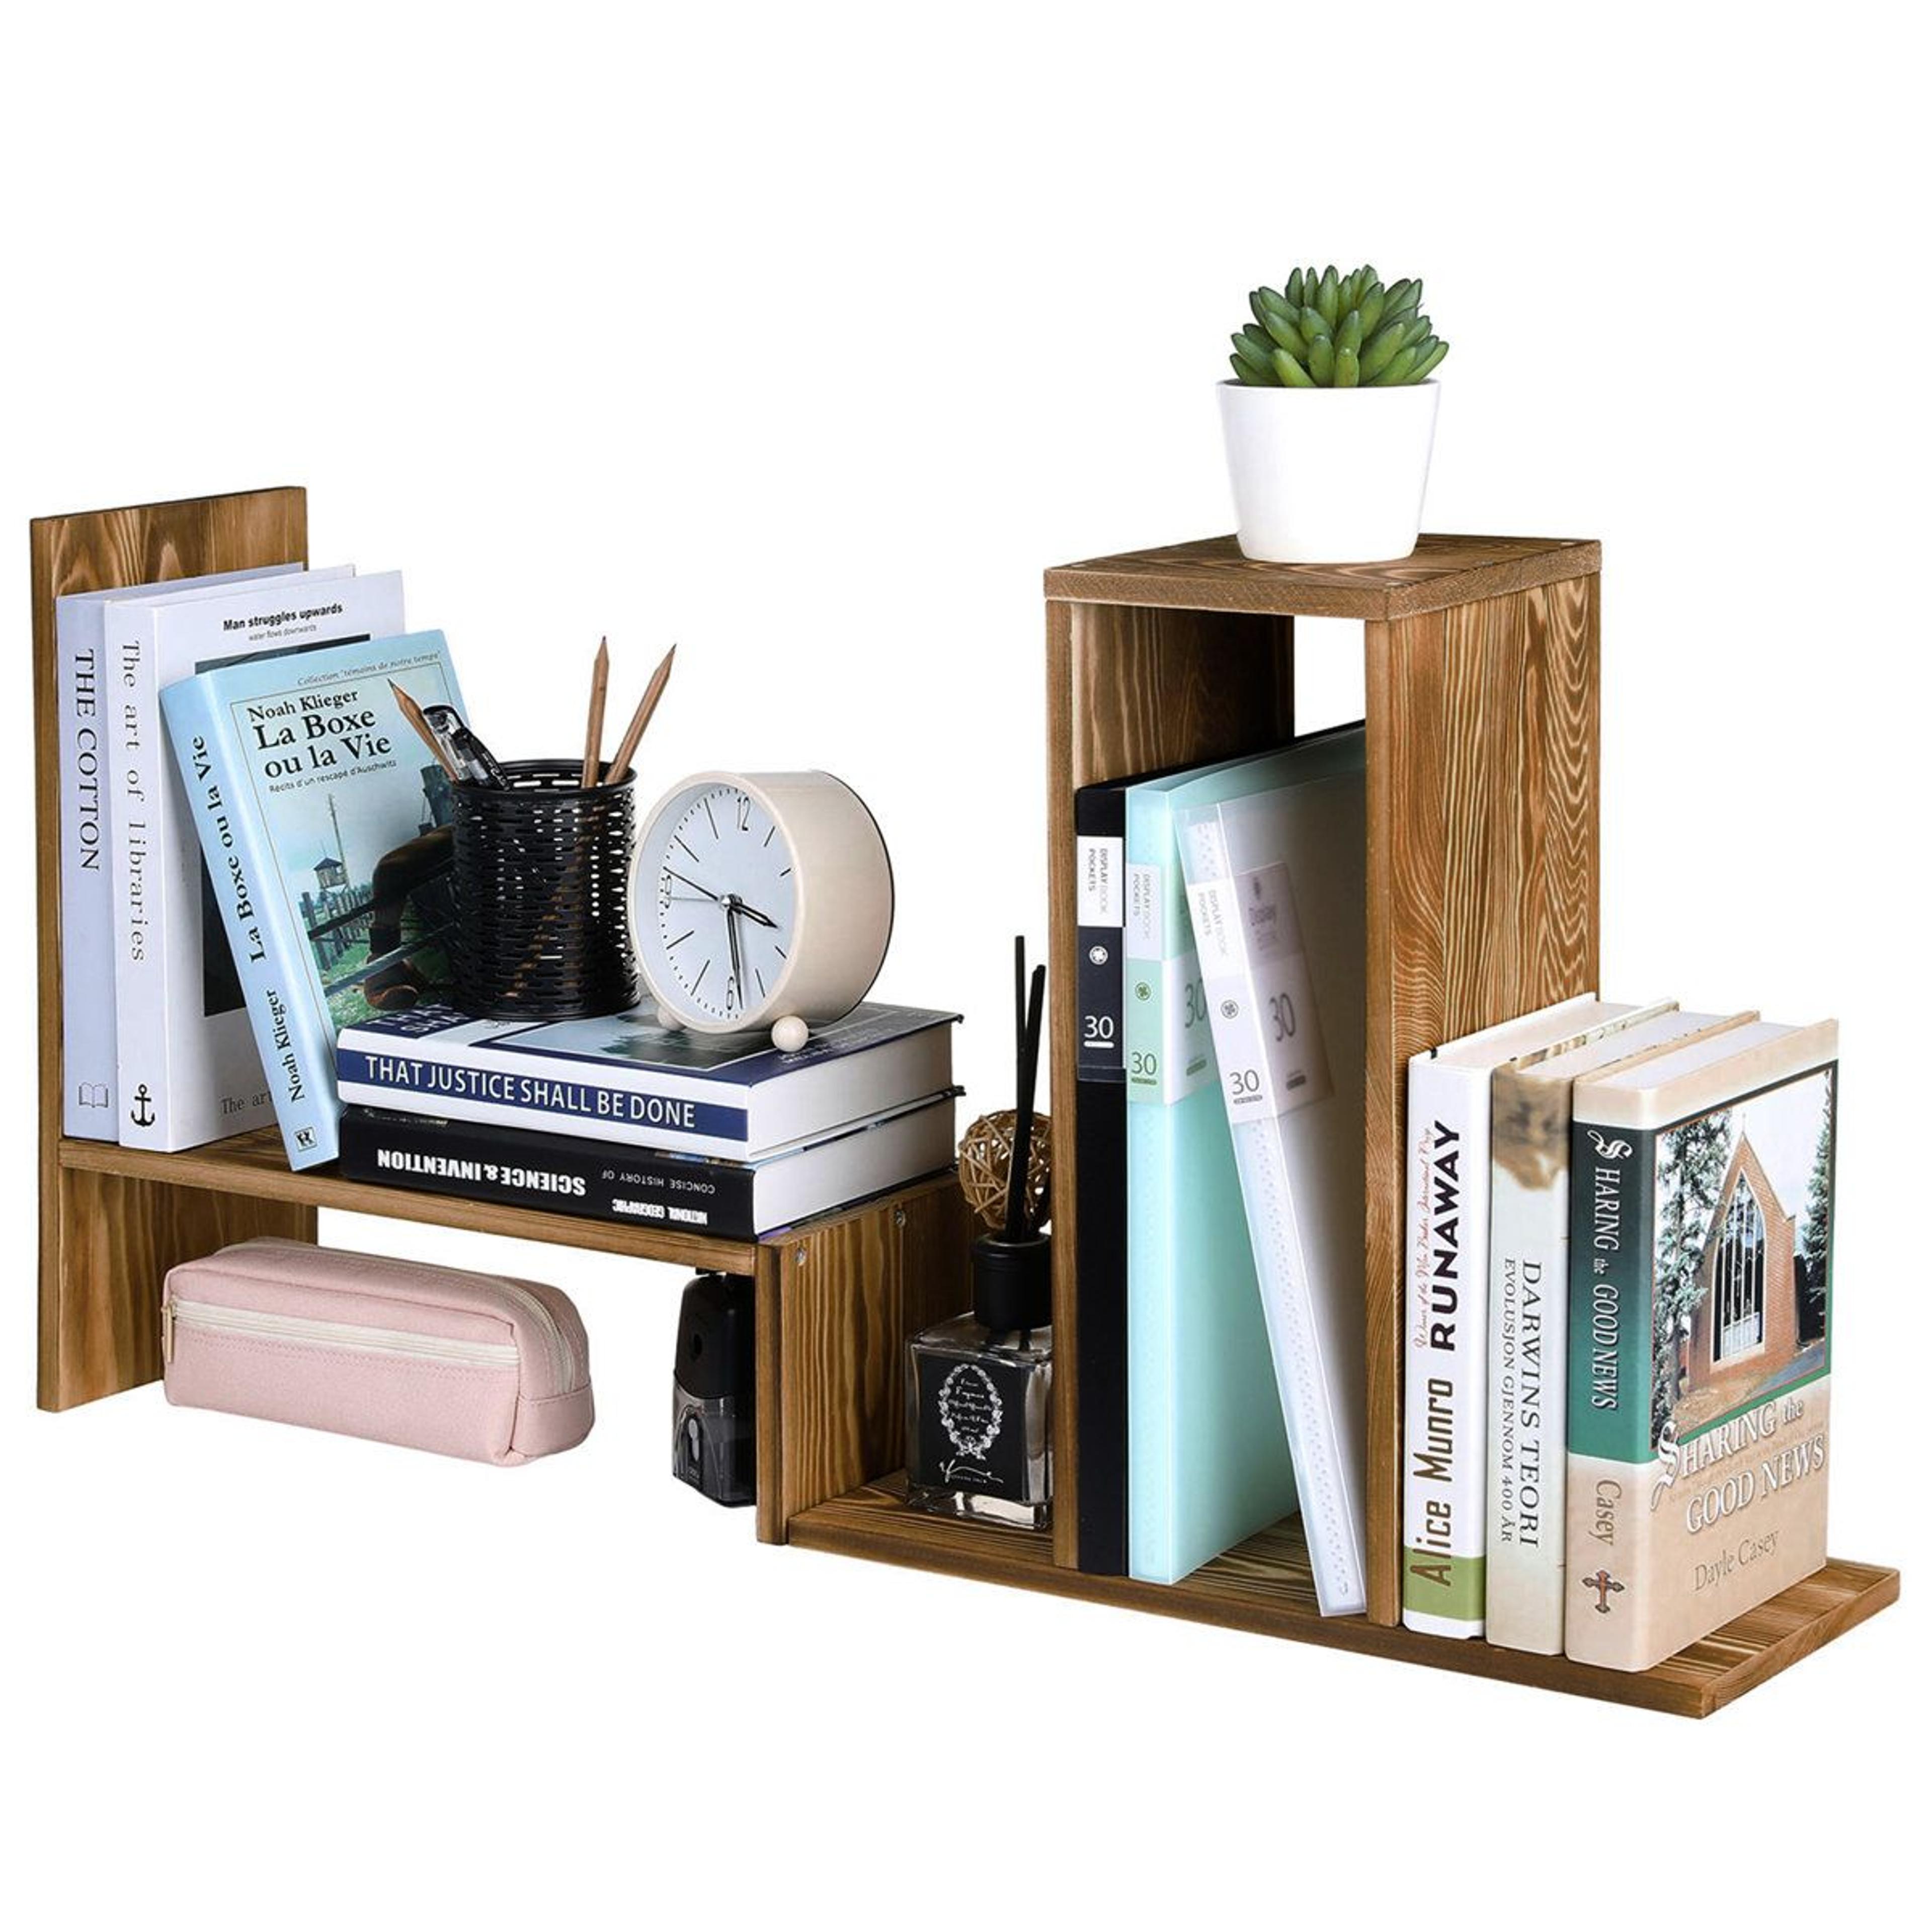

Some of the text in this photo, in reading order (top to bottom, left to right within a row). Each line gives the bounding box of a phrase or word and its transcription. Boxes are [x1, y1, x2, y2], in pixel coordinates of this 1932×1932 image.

[224, 604, 343, 631] Man struggles upwards
[247, 690, 359, 722] Noah Klieger
[253, 709, 376, 750] La Boxe
[75, 649, 100, 870] THE COTTON
[264, 733, 392, 778] ou la Vie
[122, 639, 149, 961] The art of libraries
[737, 796, 751, 831] 12
[193, 735, 266, 963] La Boxe ou la Vie
[267, 989, 305, 1102] Noah Klieger
[1084, 1015, 1114, 1039] 30
[1270, 993, 1296, 1041] 30
[365, 1055, 695, 1129] THAT JUSTICE SHALL BE DONE
[1131, 1052, 1157, 1075] 30
[1229, 1069, 1260, 1095] 30
[221, 1097, 246, 1114] The
[377, 1149, 481, 1181] INVENTION
[501, 1166, 586, 1196] SCIENCE
[602, 1170, 716, 1194] CONCISE HISTORY OF
[1430, 1120, 1460, 1351] RUNAWAY
[1587, 1130, 1634, 1410] SHARING the GOOD NEWS
[1500, 1258, 1516, 1543] EVOLUSJON GJENNOM 400 ÅR
[1519, 1261, 1542, 1548] DARWINS TEORI
[1409, 1378, 1453, 1587] Alice Munro
[1651, 1399, 1804, 1510] SHARING the
[1686, 1434, 1825, 1535] GOOD NEWS
[1588, 1478, 1623, 1547] Casey
[1694, 1530, 1781, 1591] Dayle Casey
